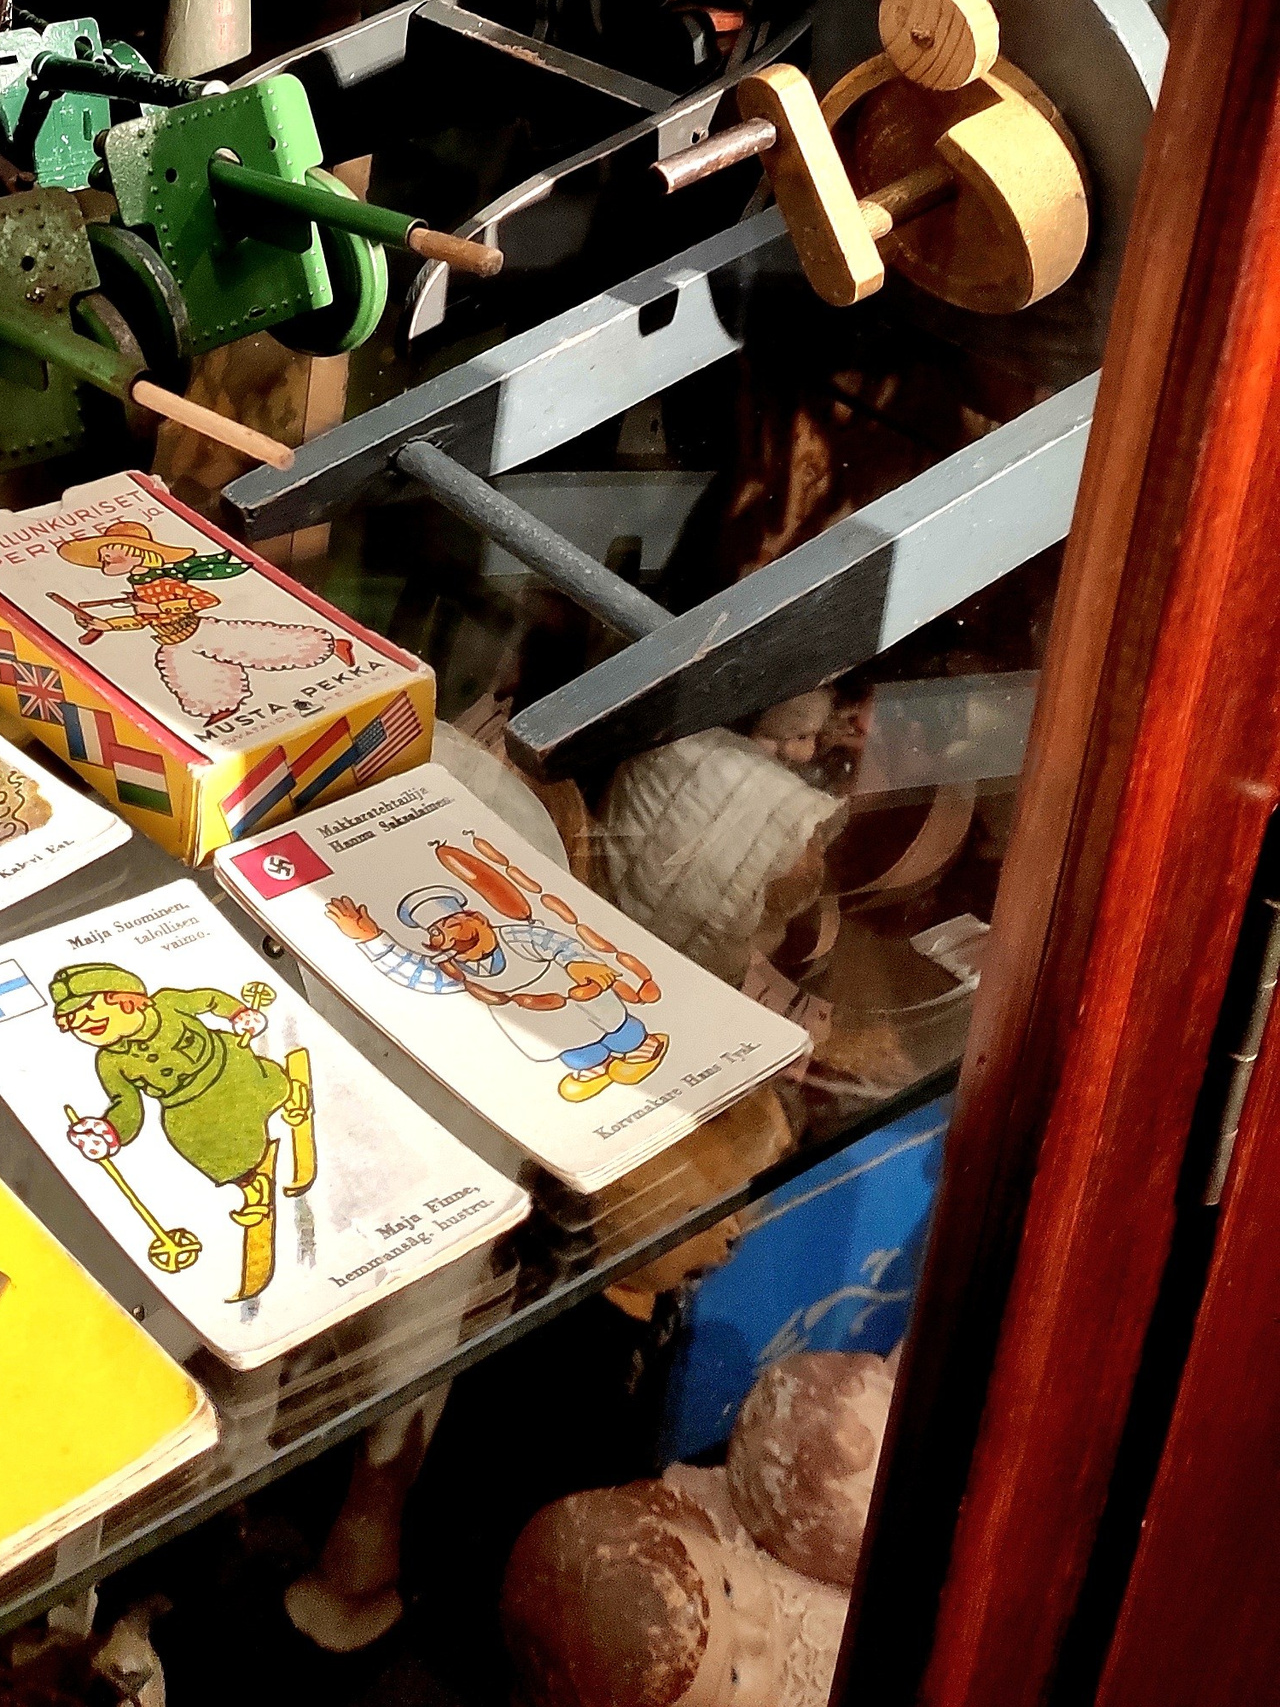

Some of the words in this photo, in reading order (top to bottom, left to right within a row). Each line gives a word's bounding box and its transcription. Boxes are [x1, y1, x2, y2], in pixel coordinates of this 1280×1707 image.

[138, 507, 165, 522] ja
[193, 702, 288, 743] MUSTA
[300, 660, 386, 699] PEKKA
[316, 786, 429, 839] Makkaratehtailija
[327, 830, 377, 853] Hannu
[66, 930, 112, 951] Maija
[134, 916, 200, 944] talollisen
[592, 1087, 683, 1140] Korvmakare
[680, 1063, 722, 1088] Hans
[375, 1213, 422, 1240] Maja
[423, 1185, 481, 1213] Finne,
[432, 1199, 495, 1231] hustru.
